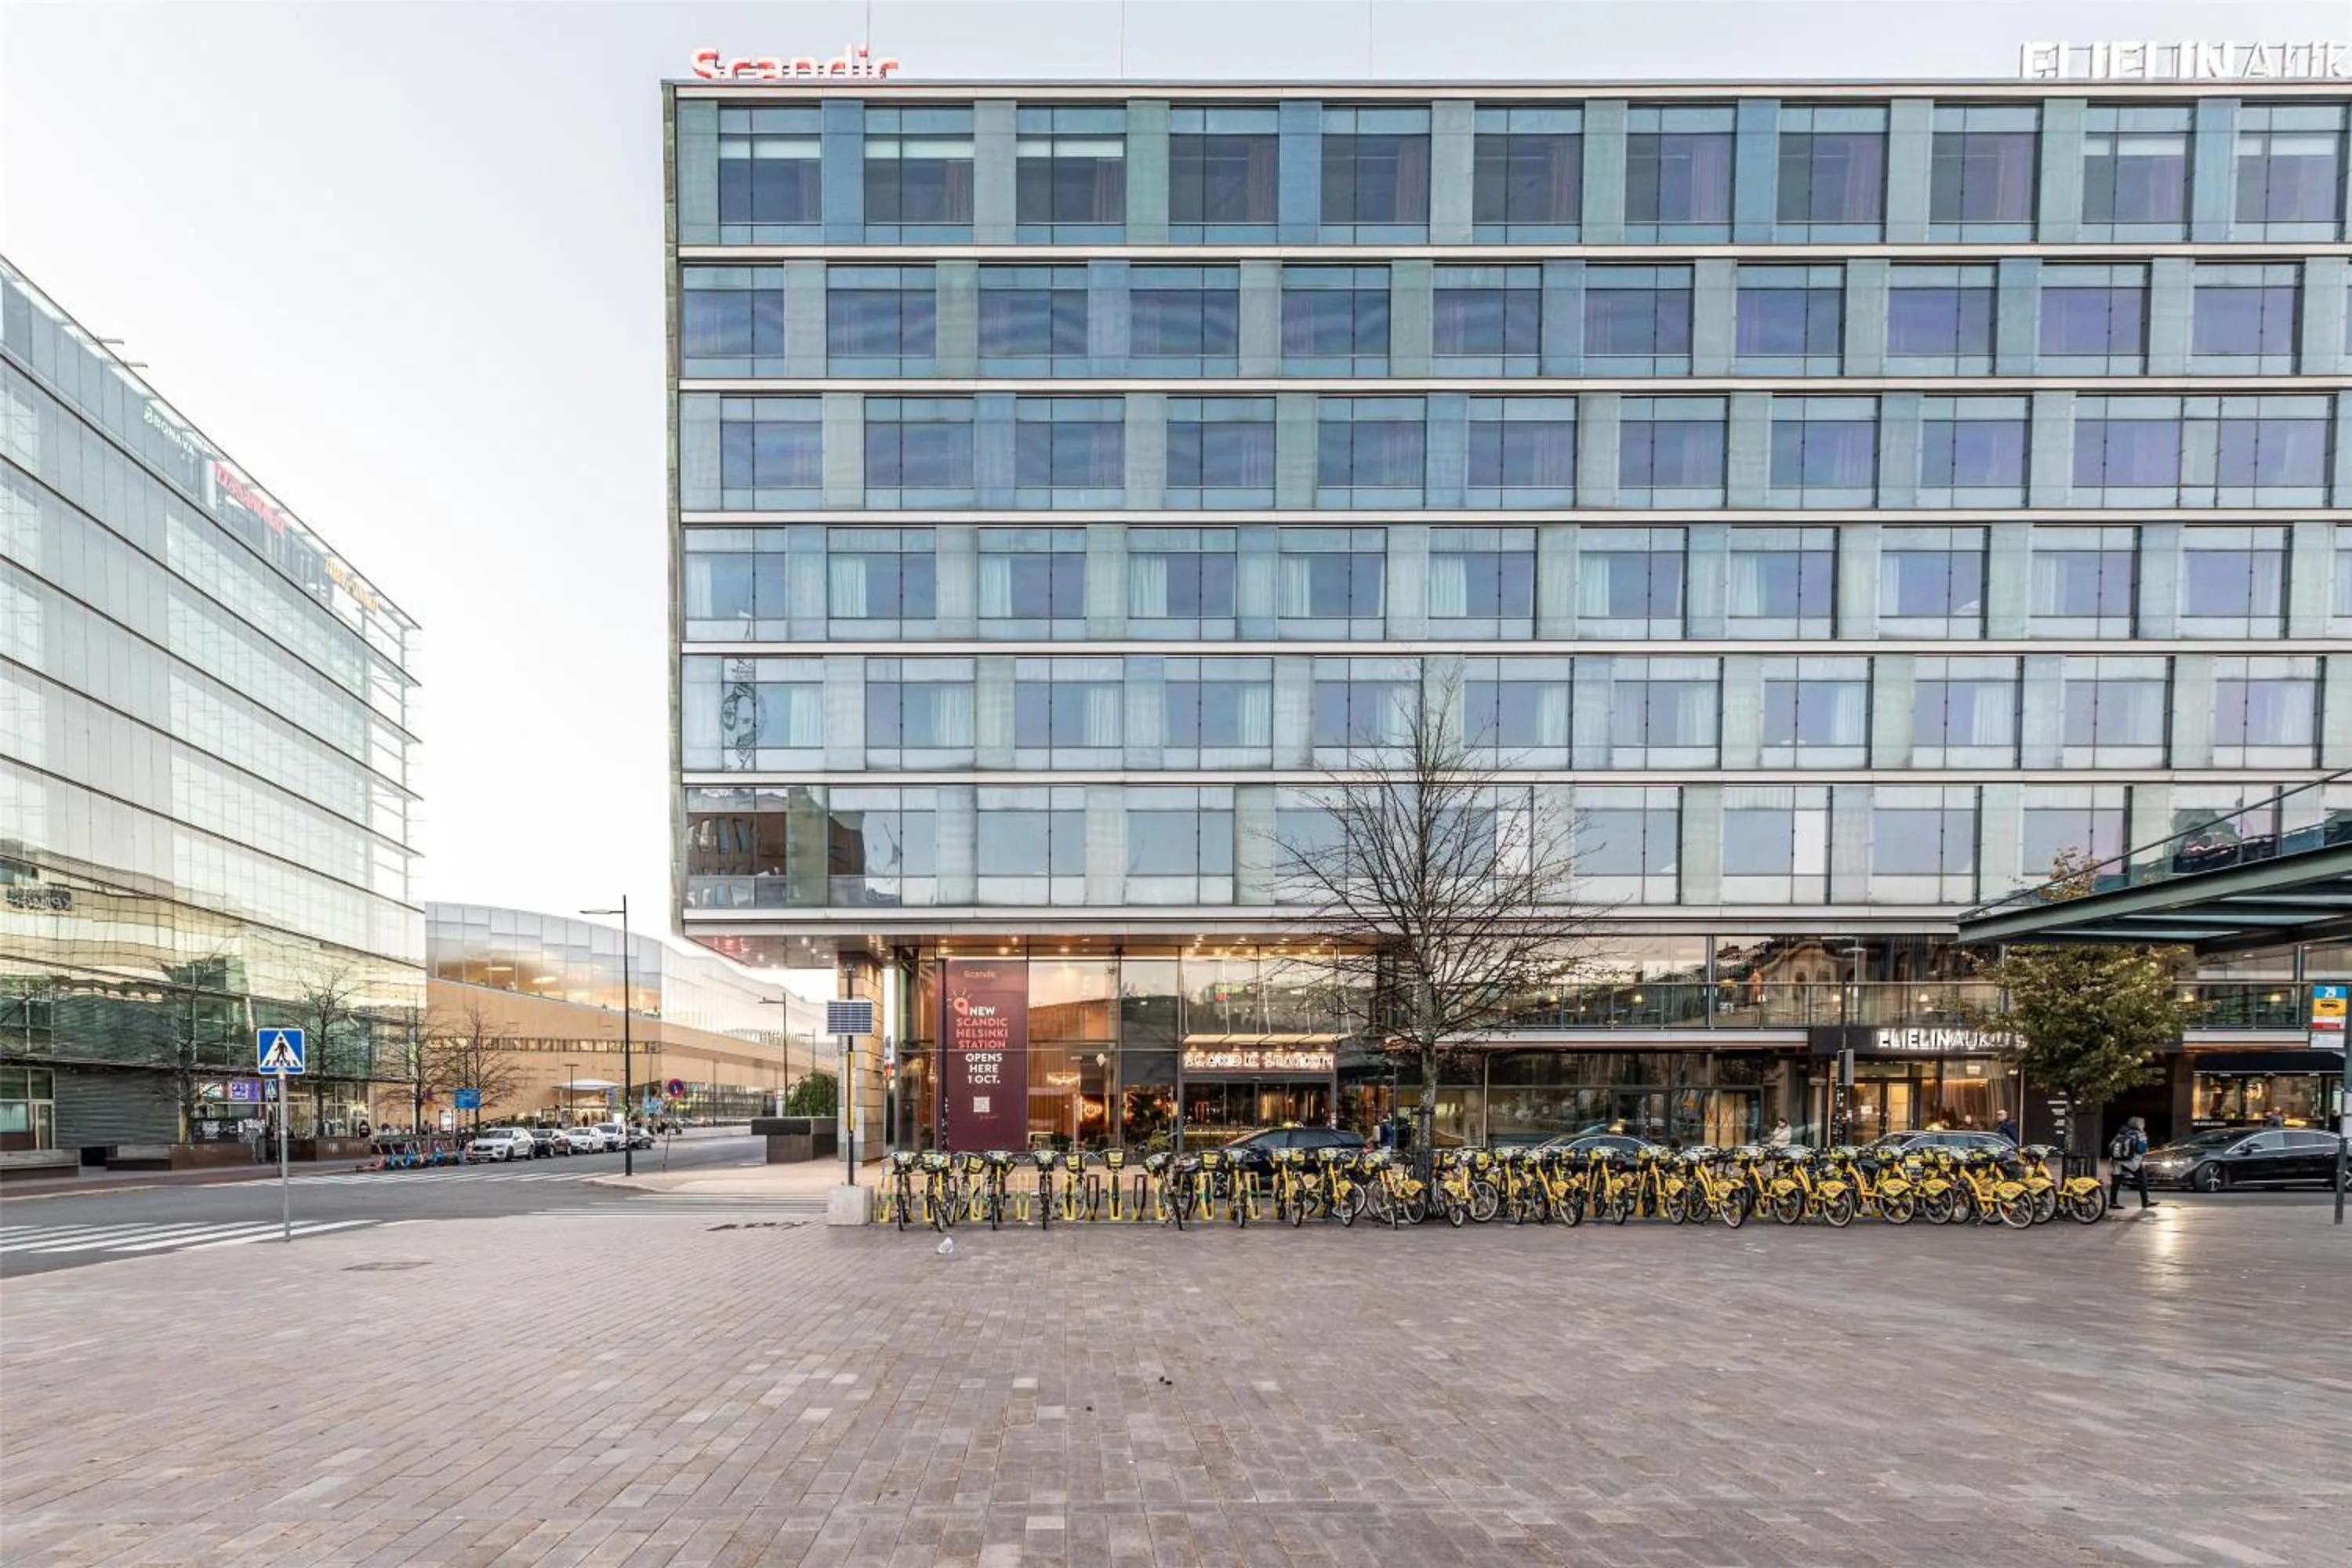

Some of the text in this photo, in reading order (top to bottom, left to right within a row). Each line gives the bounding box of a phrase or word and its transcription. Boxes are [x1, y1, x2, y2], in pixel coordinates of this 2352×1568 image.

[969, 1007, 995, 1016] NEW
[956, 1018, 1008, 1027] SCANDIC
[956, 1029, 1008, 1038] HELSINKI
[958, 1040, 1006, 1049] STATION
[965, 1053, 1003, 1062] OPENS
[1184, 1051, 1334, 1069] SCANDIC STATION
[969, 1064, 999, 1073] HERE
[967, 1075, 1000, 1084] 1 OCT.
